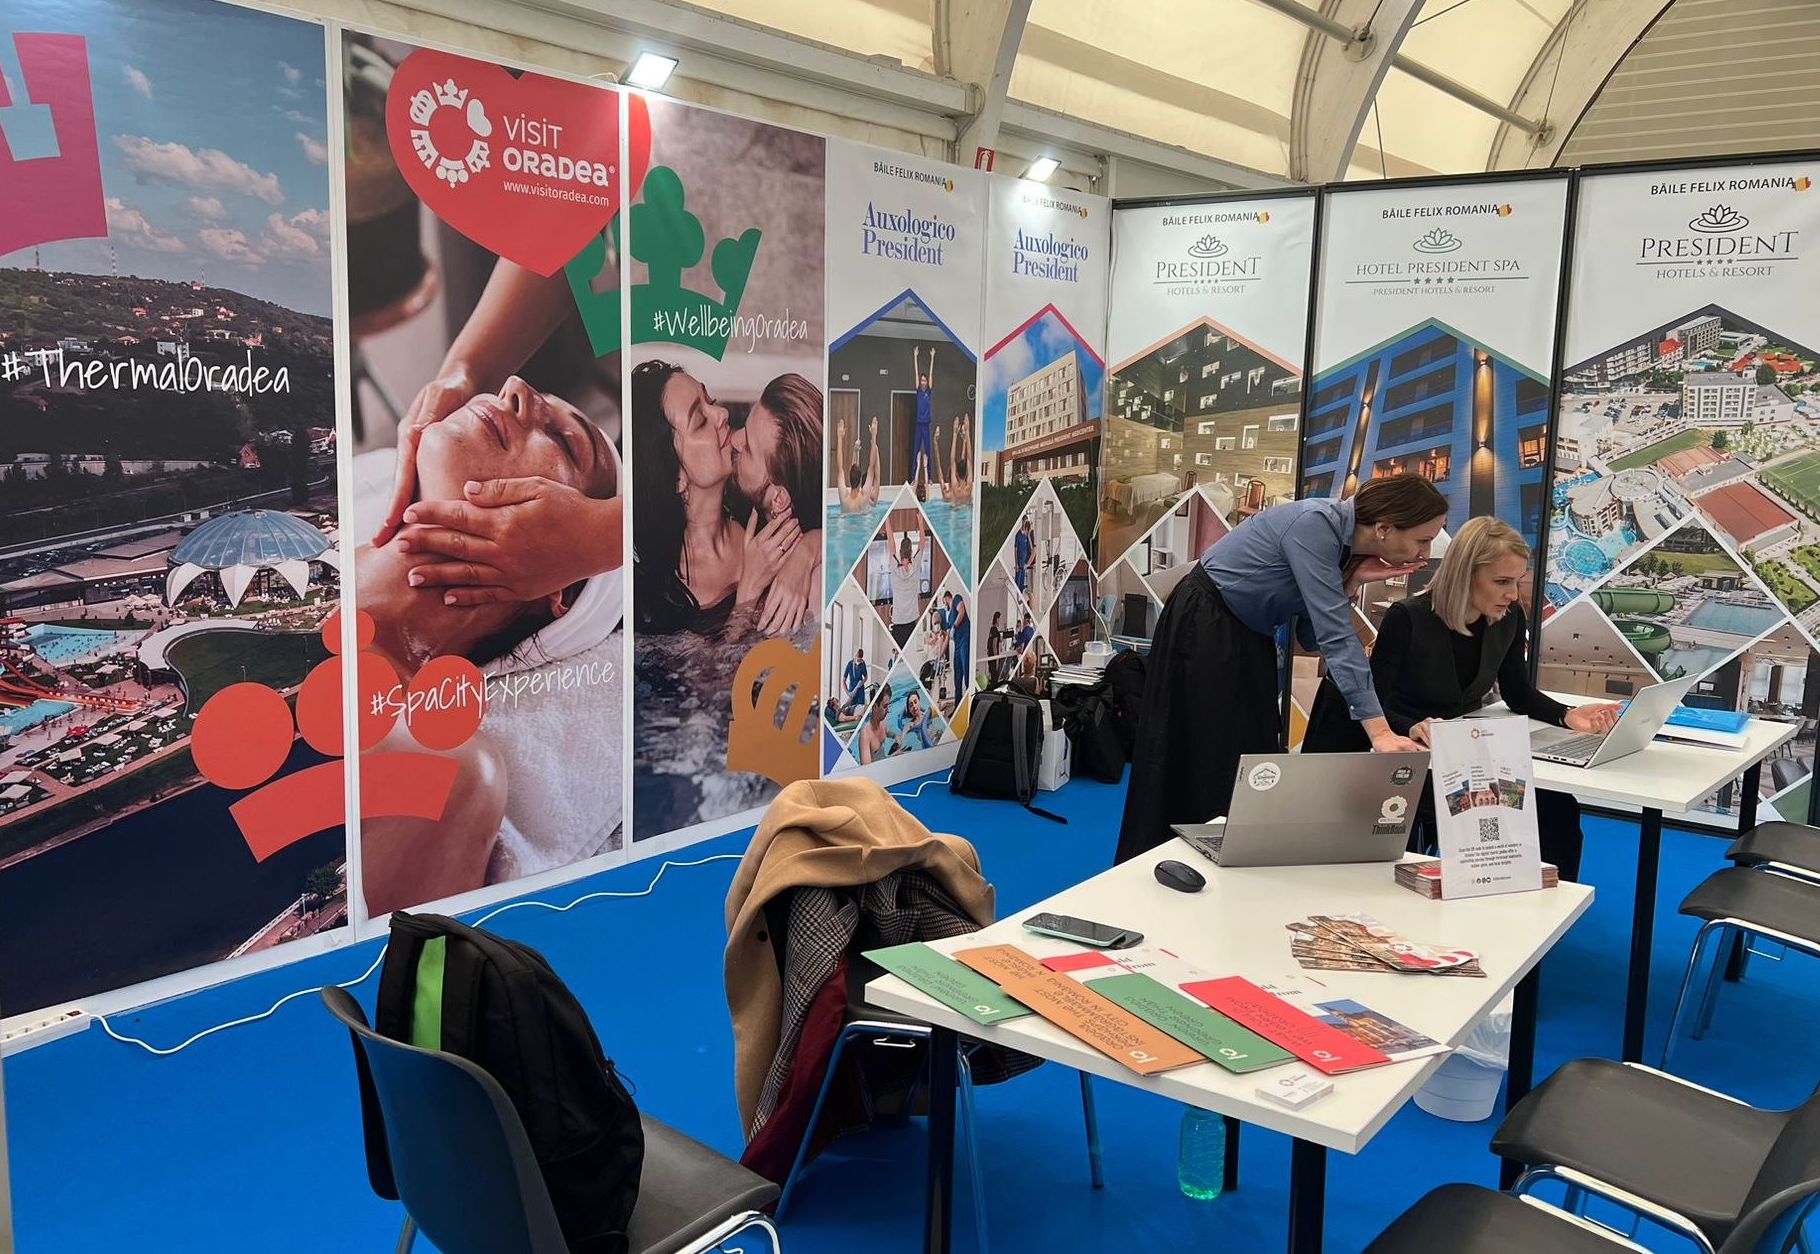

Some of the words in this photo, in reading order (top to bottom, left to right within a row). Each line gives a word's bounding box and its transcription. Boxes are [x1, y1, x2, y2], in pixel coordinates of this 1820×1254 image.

[895, 167, 914, 180] FELIX
[914, 171, 947, 188] ROMANIA
[1690, 180, 1726, 193] FELIX
[1729, 177, 1796, 190] ROMANIA
[503, 181, 609, 207] www.visitoradea.com
[1056, 201, 1082, 216] ROMANIA
[1189, 214, 1213, 225] FELIX
[1215, 211, 1260, 223] ROMANIA
[1414, 206, 1443, 218] FELIX
[1445, 203, 1499, 216] ROMANIA
[862, 200, 955, 244] Auxologico
[862, 228, 944, 266] President
[1013, 227, 1089, 264] Auxologico
[1641, 231, 1800, 258] PRESIDENT
[1013, 251, 1078, 283] President
[1156, 256, 1262, 278] PRESIDENT
[1356, 263, 1404, 276] HOTEL
[1407, 259, 1491, 275] PRESIDENT
[1493, 258, 1521, 272] SPA
[1656, 268, 1706, 279] HOTELS
[1708, 267, 1719, 278] &
[1722, 266, 1775, 277] RESORT
[1167, 286, 1200, 297] HOTELS
[1211, 284, 1246, 295] RESORT
[1373, 287, 1418, 296] PRESIDENT
[1421, 286, 1453, 295] HOTELS
[1463, 285, 1496, 294] RESORT
[653, 303, 809, 354] #WellbeingOradea
[370, 661, 616, 727] #SpaCityExperience
